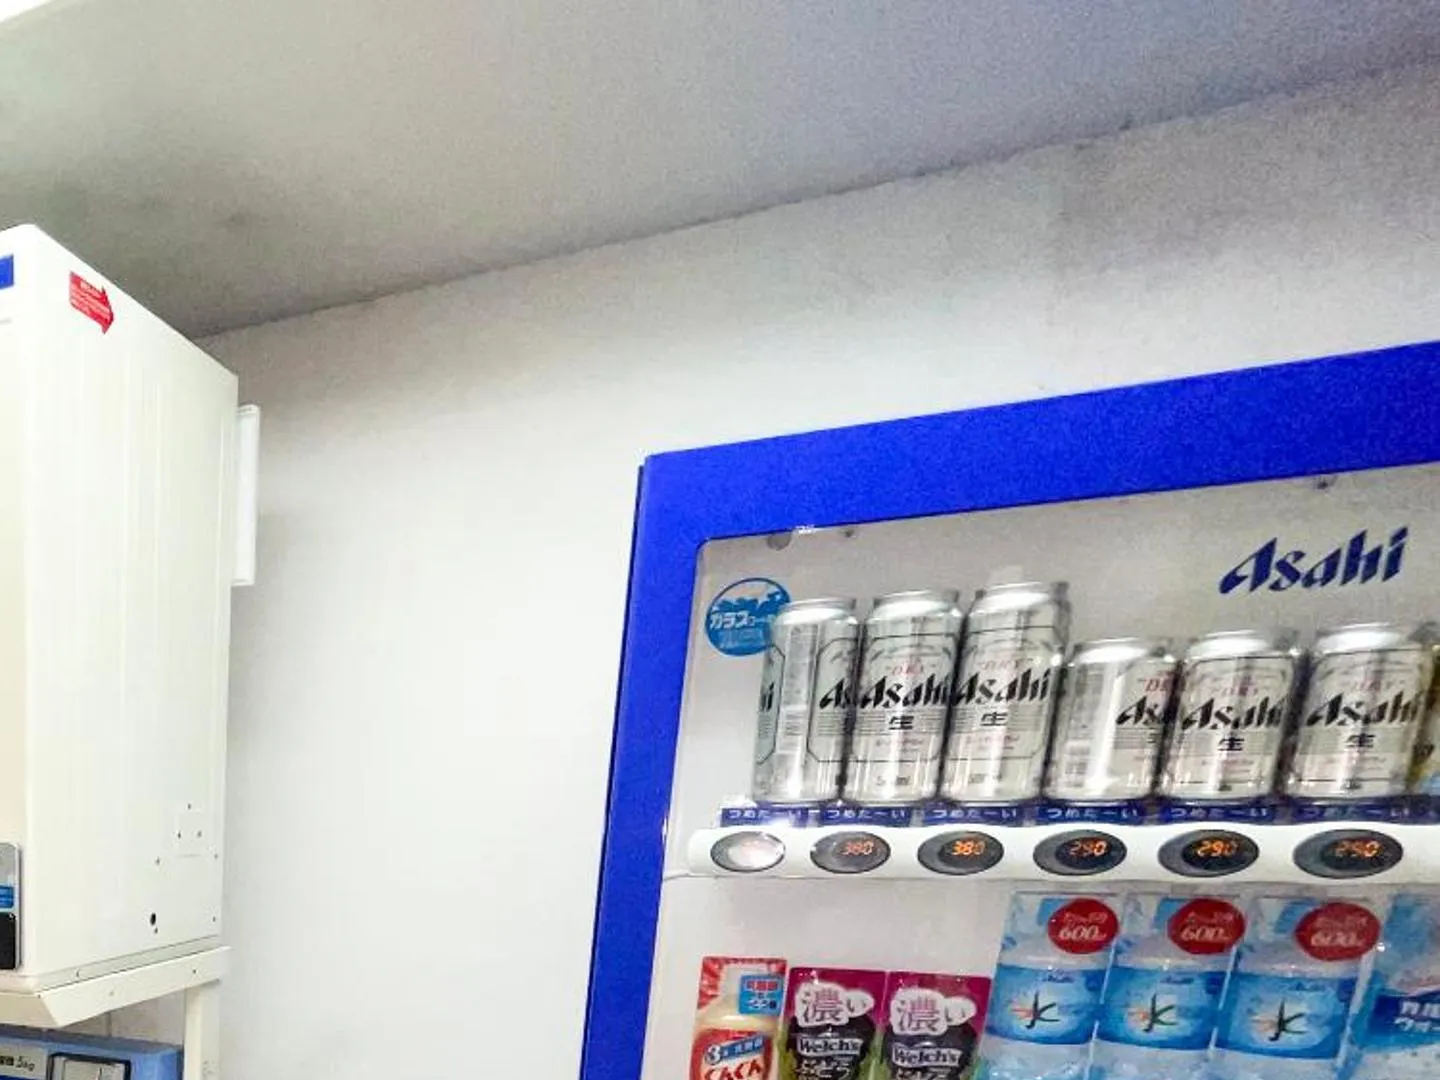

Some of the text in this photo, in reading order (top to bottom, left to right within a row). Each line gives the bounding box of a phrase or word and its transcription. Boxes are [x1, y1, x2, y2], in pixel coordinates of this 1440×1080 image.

[1218, 526, 1409, 594] Asahi
[952, 668, 1052, 706] Asahi
[979, 711, 1008, 727] 生
[1217, 736, 1245, 752] 生
[801, 987, 866, 1023] 濃い
[898, 993, 966, 1032] 濃い
